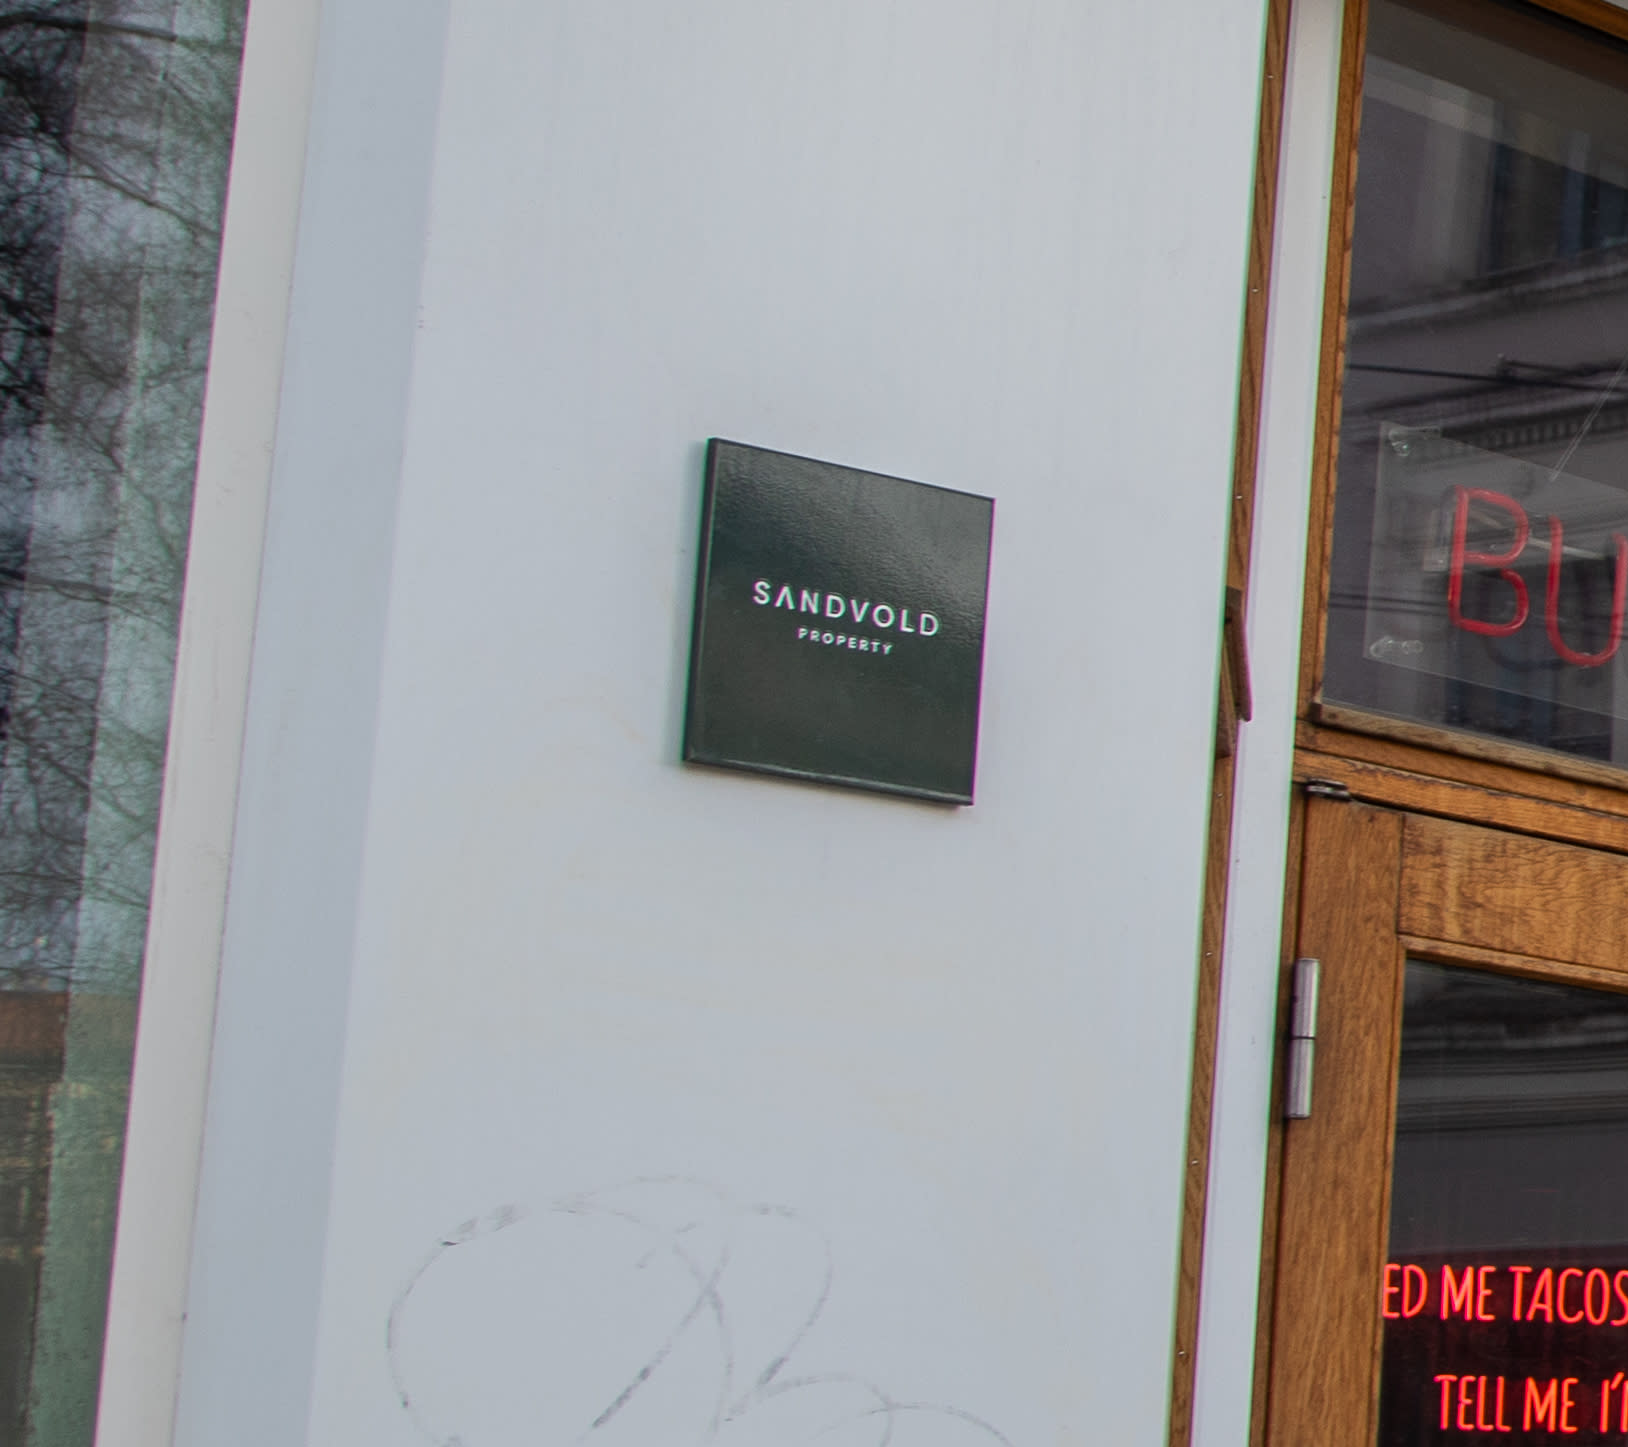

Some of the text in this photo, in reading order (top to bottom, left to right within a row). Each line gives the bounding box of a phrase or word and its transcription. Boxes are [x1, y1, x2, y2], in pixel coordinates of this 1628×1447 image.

[752, 579, 942, 637] SANDVOLD
[797, 627, 893, 656] PROPERTY
[1440, 1264, 1497, 1322] ME
[1433, 1374, 1512, 1432] TELL
[1522, 1376, 1579, 1433] ME
